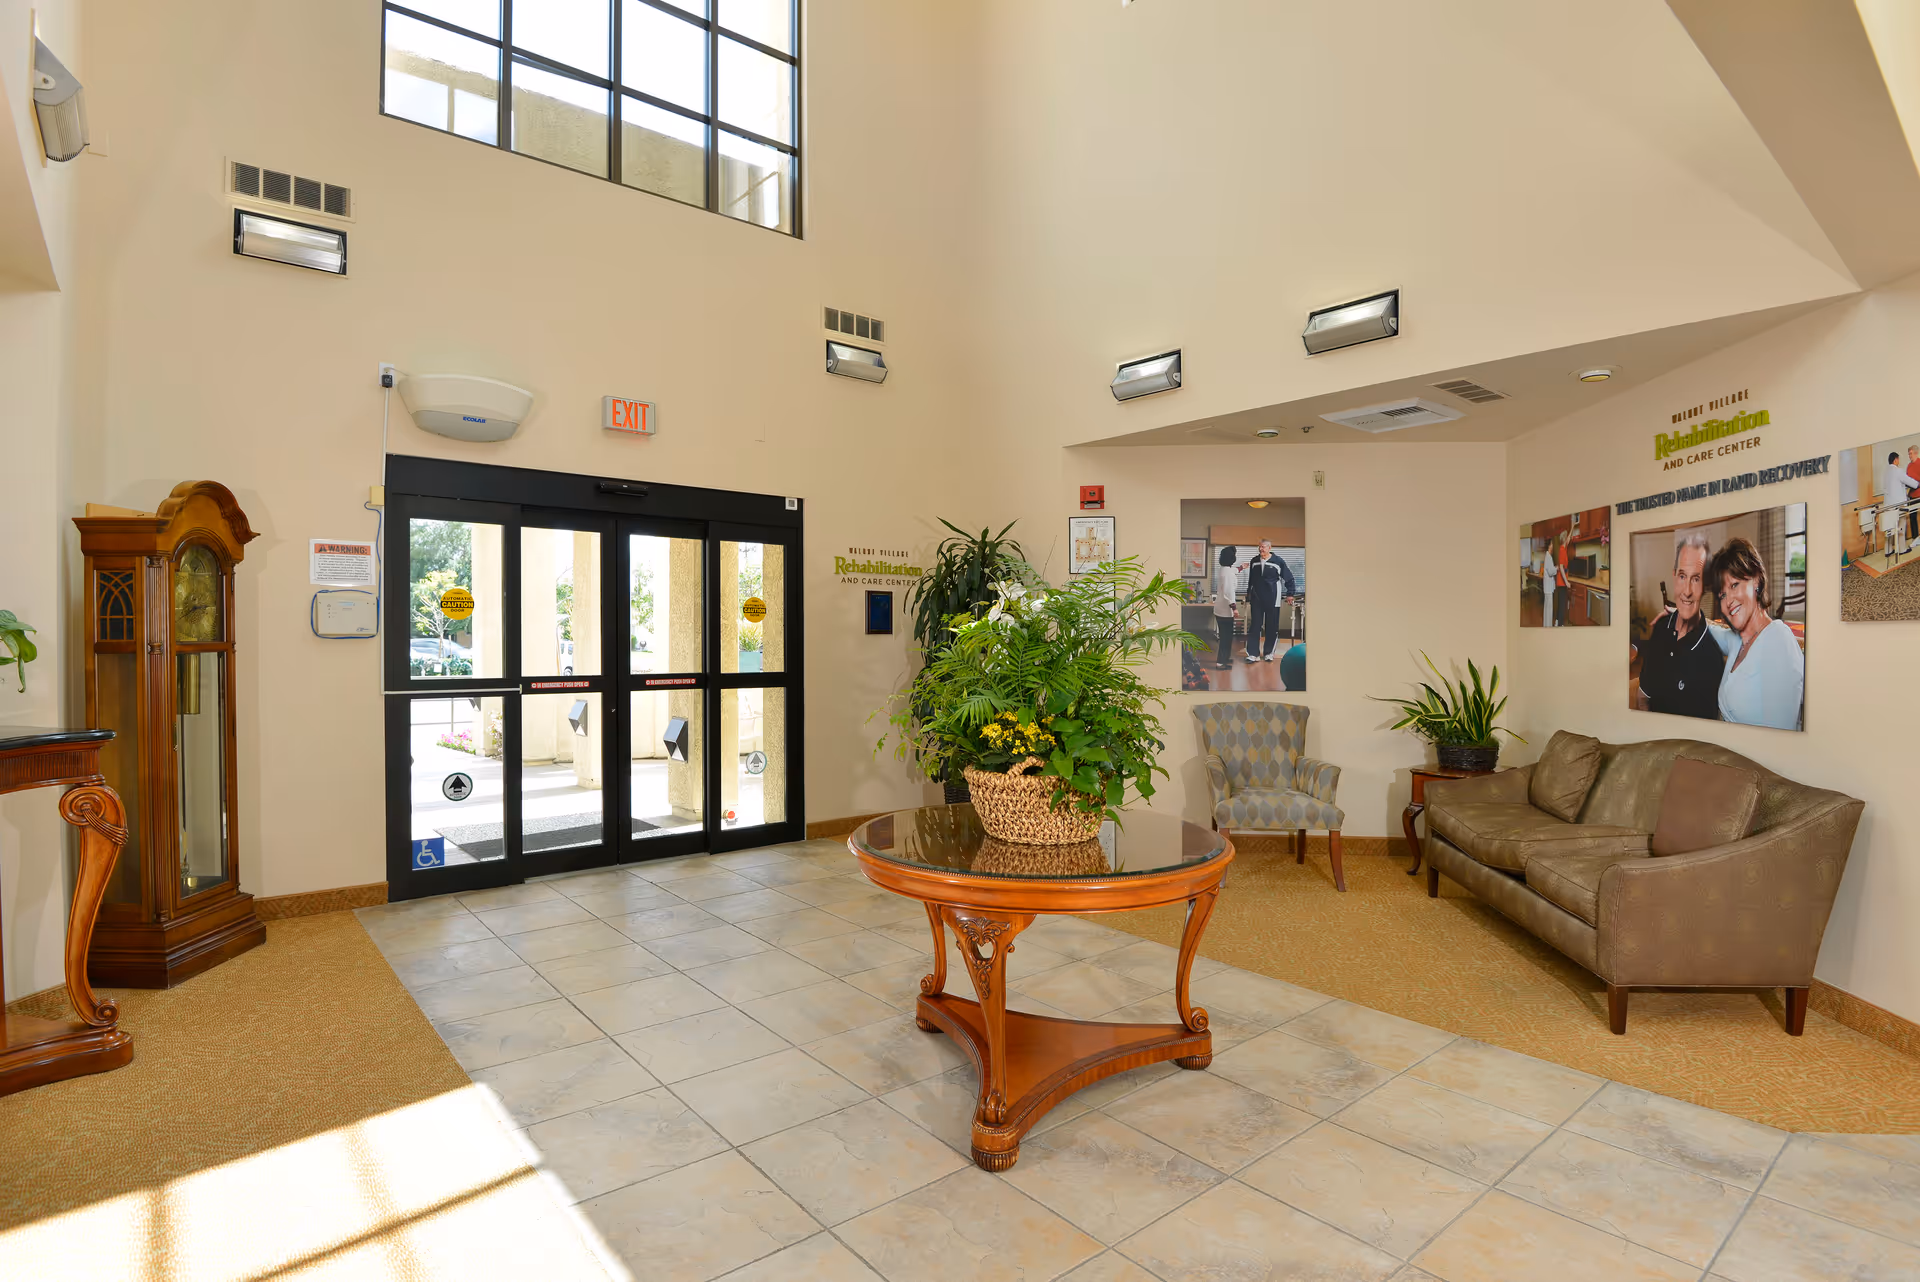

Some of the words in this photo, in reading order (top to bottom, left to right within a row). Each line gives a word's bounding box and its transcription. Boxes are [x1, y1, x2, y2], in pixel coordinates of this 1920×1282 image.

[612, 399, 650, 431] EXIT
[1672, 405, 1703, 424] WALNUT
[1709, 389, 1748, 411] VILLAGE
[1654, 410, 1770, 461] Rehabilitation
[1663, 458, 1684, 471] AND
[1687, 449, 1714, 465] CARE
[1717, 437, 1761, 457] CENTER
[1616, 500, 1634, 515] THE
[1633, 491, 1676, 512] TRUSTED
[1676, 484, 1707, 504] NAME
[1708, 480, 1721, 496] IN
[1721, 473, 1758, 494] RAPID
[1758, 455, 1831, 486] RECOVERY
[834, 556, 923, 577] Rehabilitation
[841, 577, 859, 585] AND
[861, 577, 883, 586] CARE
[885, 579, 917, 587] CENTER
